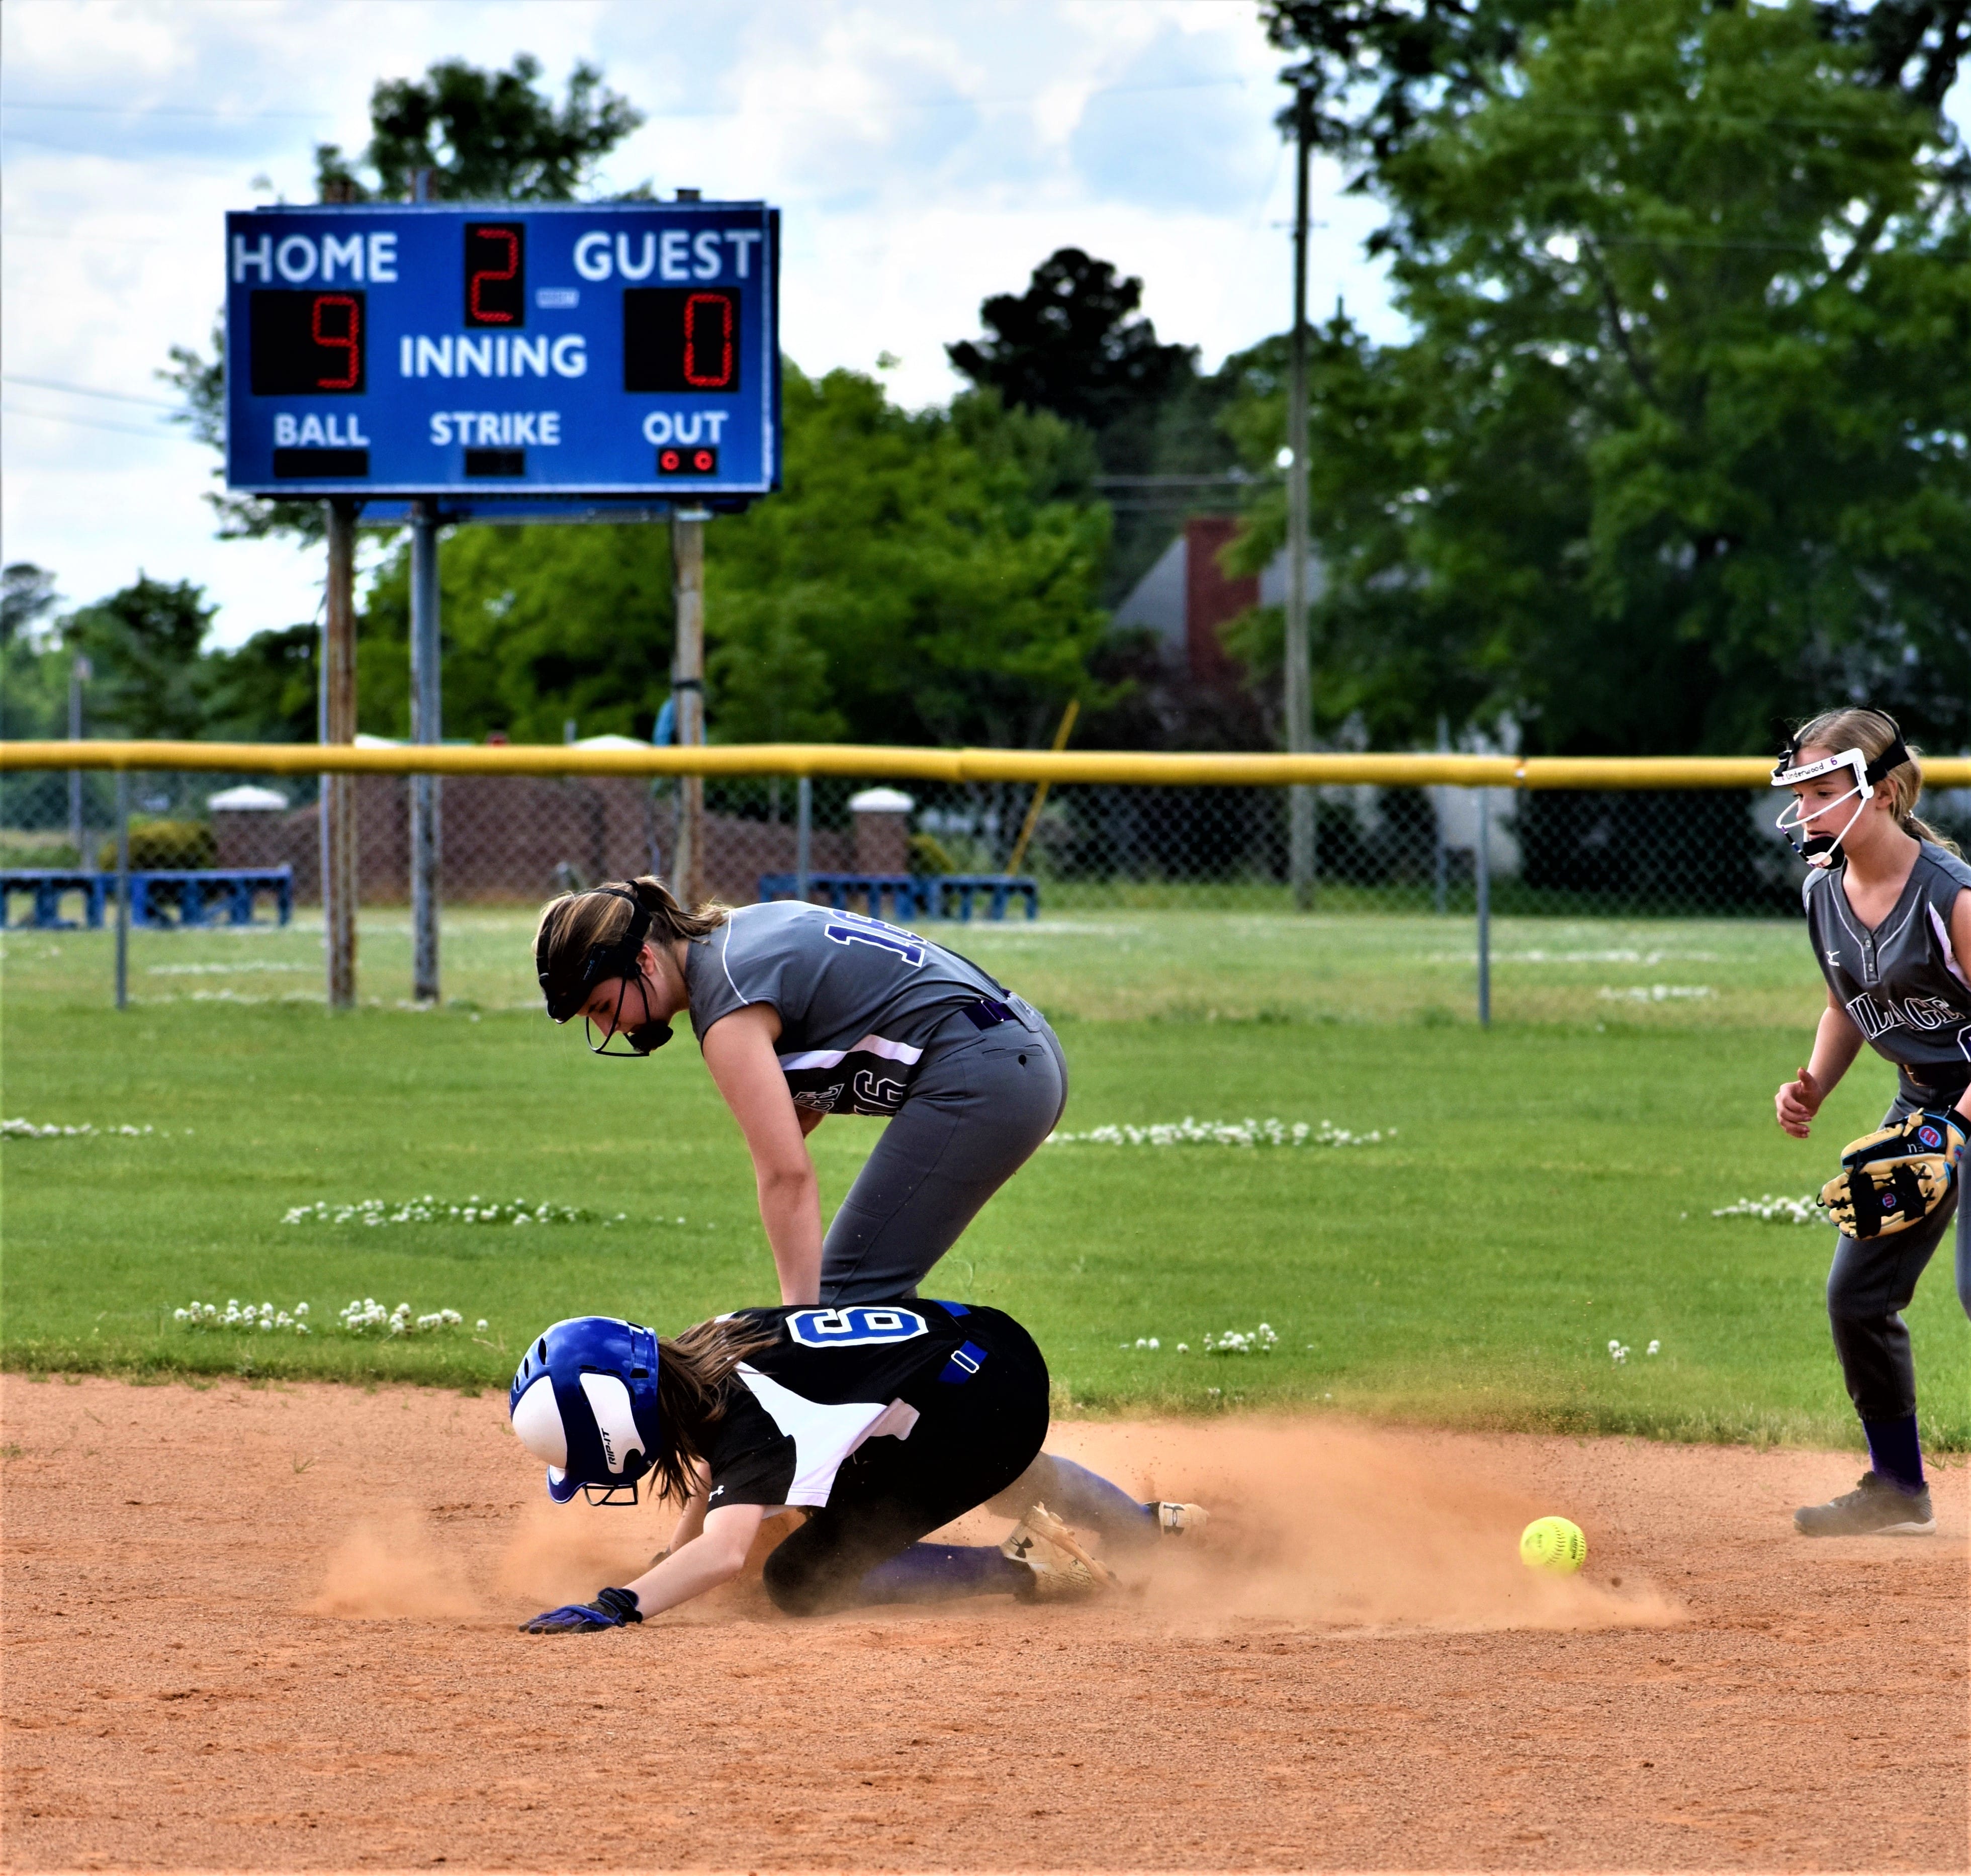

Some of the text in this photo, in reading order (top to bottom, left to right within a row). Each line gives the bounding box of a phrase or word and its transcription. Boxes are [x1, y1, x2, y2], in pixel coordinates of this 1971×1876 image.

[234, 233, 397, 283] HOME
[472, 229, 517, 322] 2
[573, 231, 760, 281] GUEST
[313, 297, 359, 388] 9
[400, 334, 587, 378] INNING
[684, 294, 732, 387] 0
[275, 414, 370, 446] BALL
[430, 412, 560, 445] STRIKE
[643, 412, 728, 445] OUT
[1785, 762, 1824, 779] Underwood
[1830, 757, 1838, 765] 6
[785, 1306, 929, 1349] 6
[601, 1427, 617, 1465] RIP-IT
